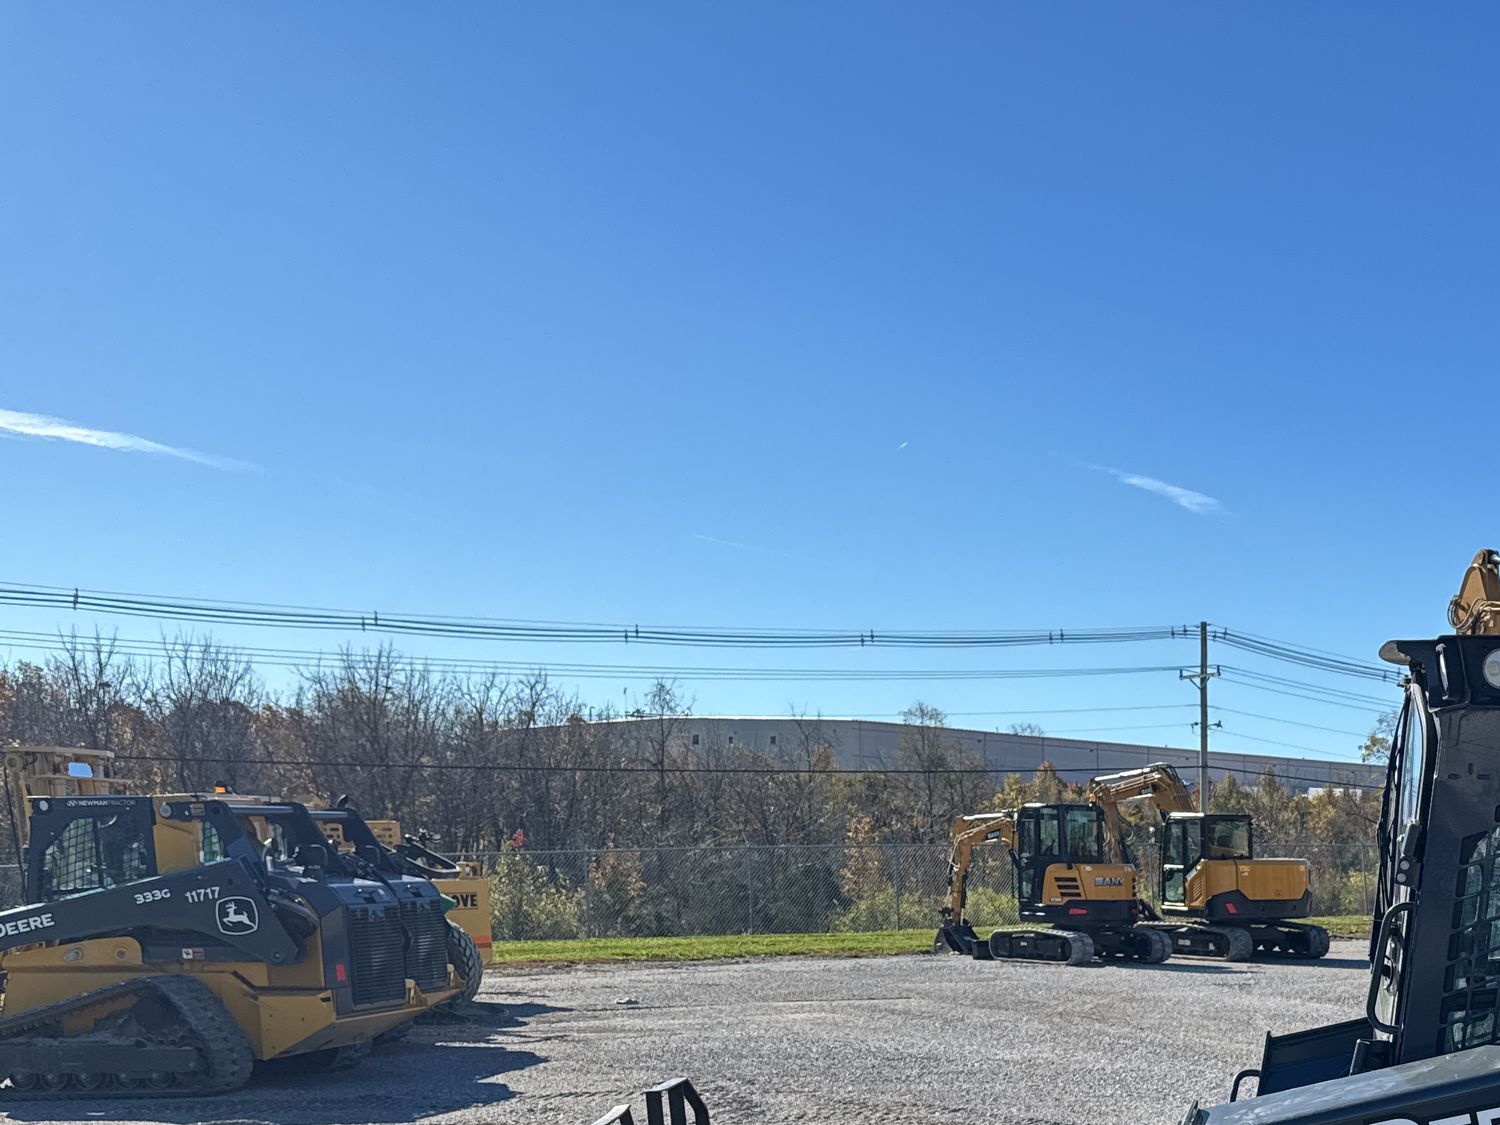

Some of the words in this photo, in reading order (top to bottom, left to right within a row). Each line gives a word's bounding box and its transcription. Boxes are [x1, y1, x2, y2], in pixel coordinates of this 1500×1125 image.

[133, 888, 171, 905] 333G
[184, 886, 220, 904] 11717
[451, 894, 478, 908] OVE
